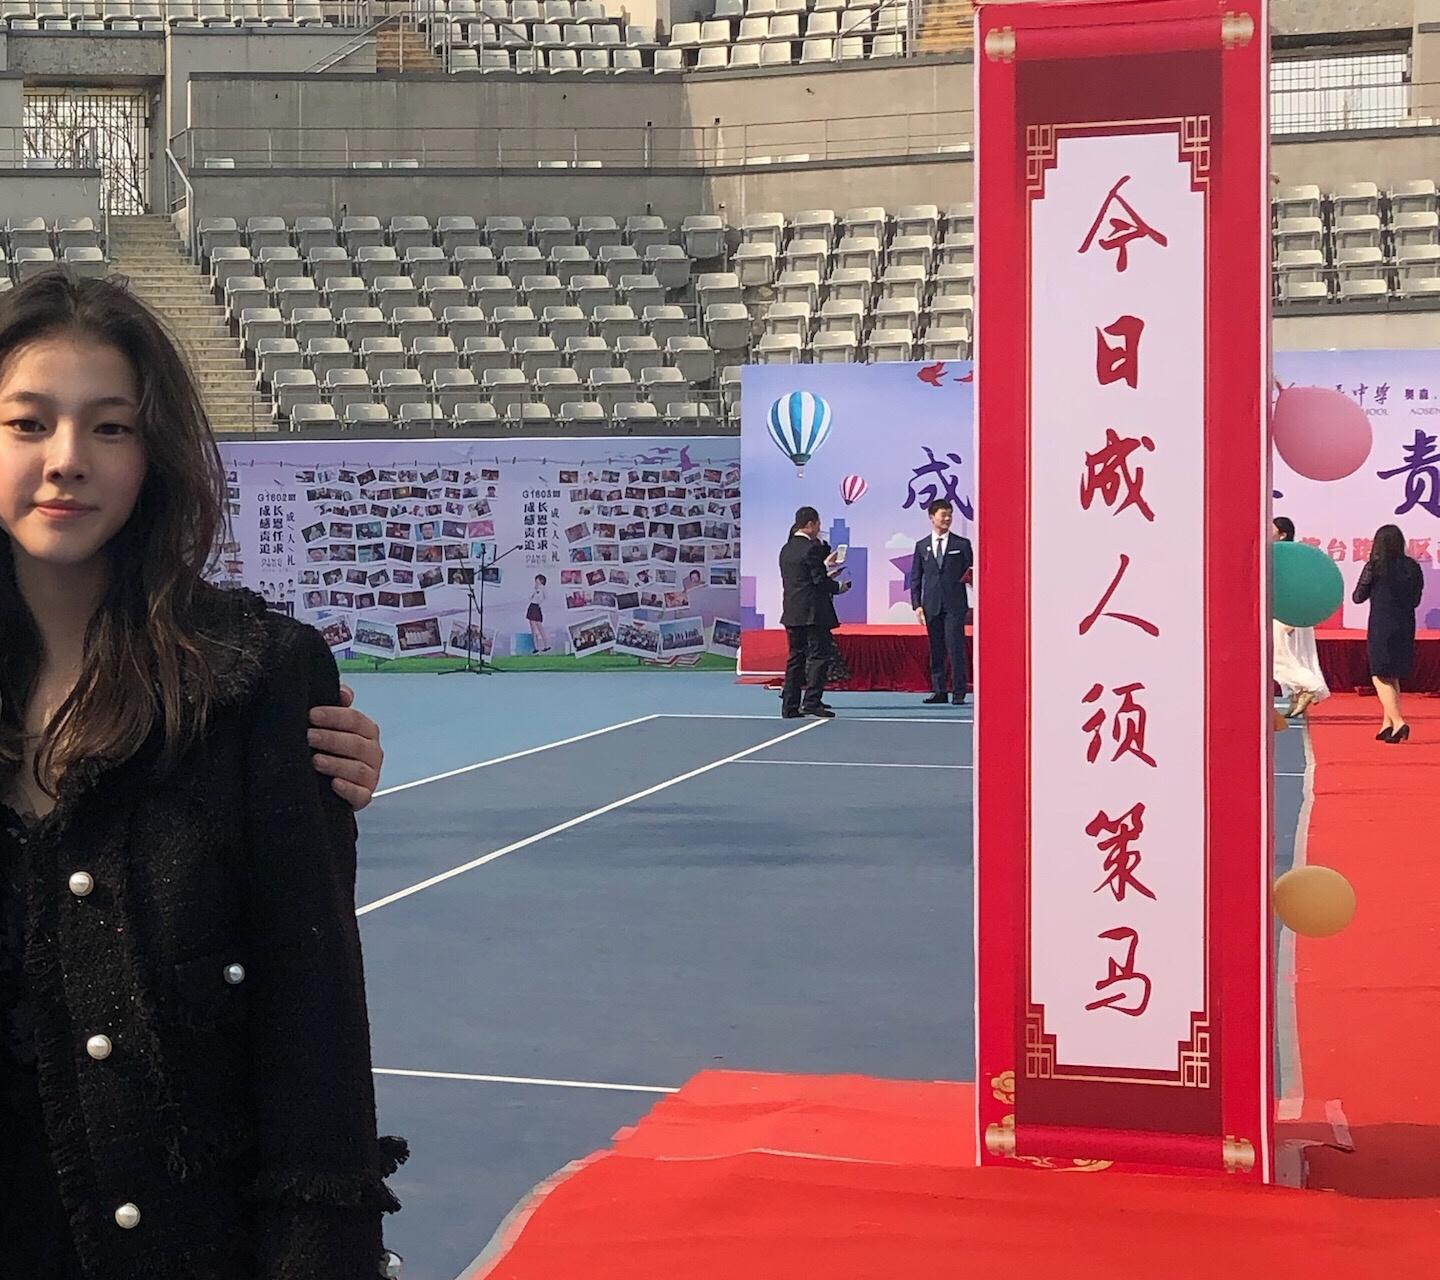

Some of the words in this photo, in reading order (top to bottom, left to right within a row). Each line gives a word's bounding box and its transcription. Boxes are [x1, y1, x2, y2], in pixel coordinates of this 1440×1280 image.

[1077, 175, 1169, 1019] 今日成人须策马
